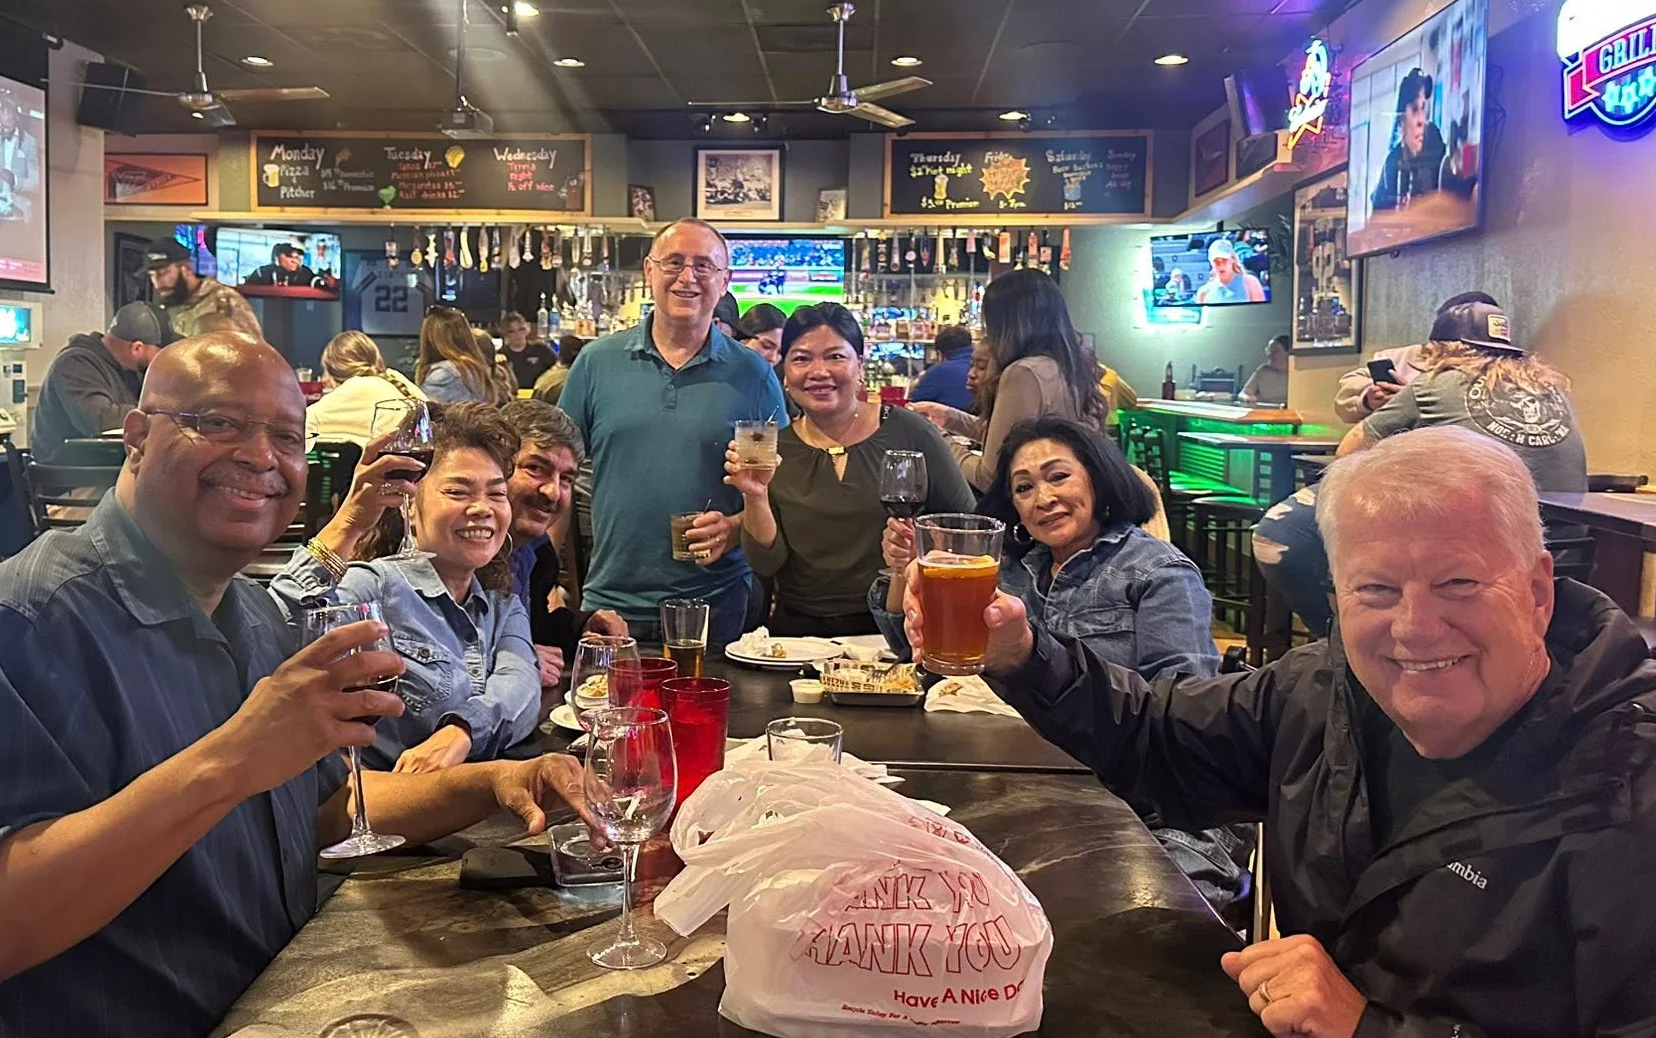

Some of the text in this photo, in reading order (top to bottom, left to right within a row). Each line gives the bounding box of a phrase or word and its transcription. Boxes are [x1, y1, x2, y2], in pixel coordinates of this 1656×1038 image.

[270, 143, 325, 170] Monday
[383, 147, 431, 169] Tuesday
[493, 147, 557, 169] Wednesday
[910, 151, 961, 167] Thursday
[281, 164, 309, 176] Pizza
[946, 163, 973, 177] night
[281, 186, 315, 199] Pitcher
[518, 181, 534, 191] off
[374, 285, 408, 312] 22
[938, 871, 990, 913] YO
[797, 915, 1021, 977] HANK YOU
[894, 990, 939, 1008] Have
[942, 988, 957, 1004] A
[961, 987, 999, 1005] Nice
